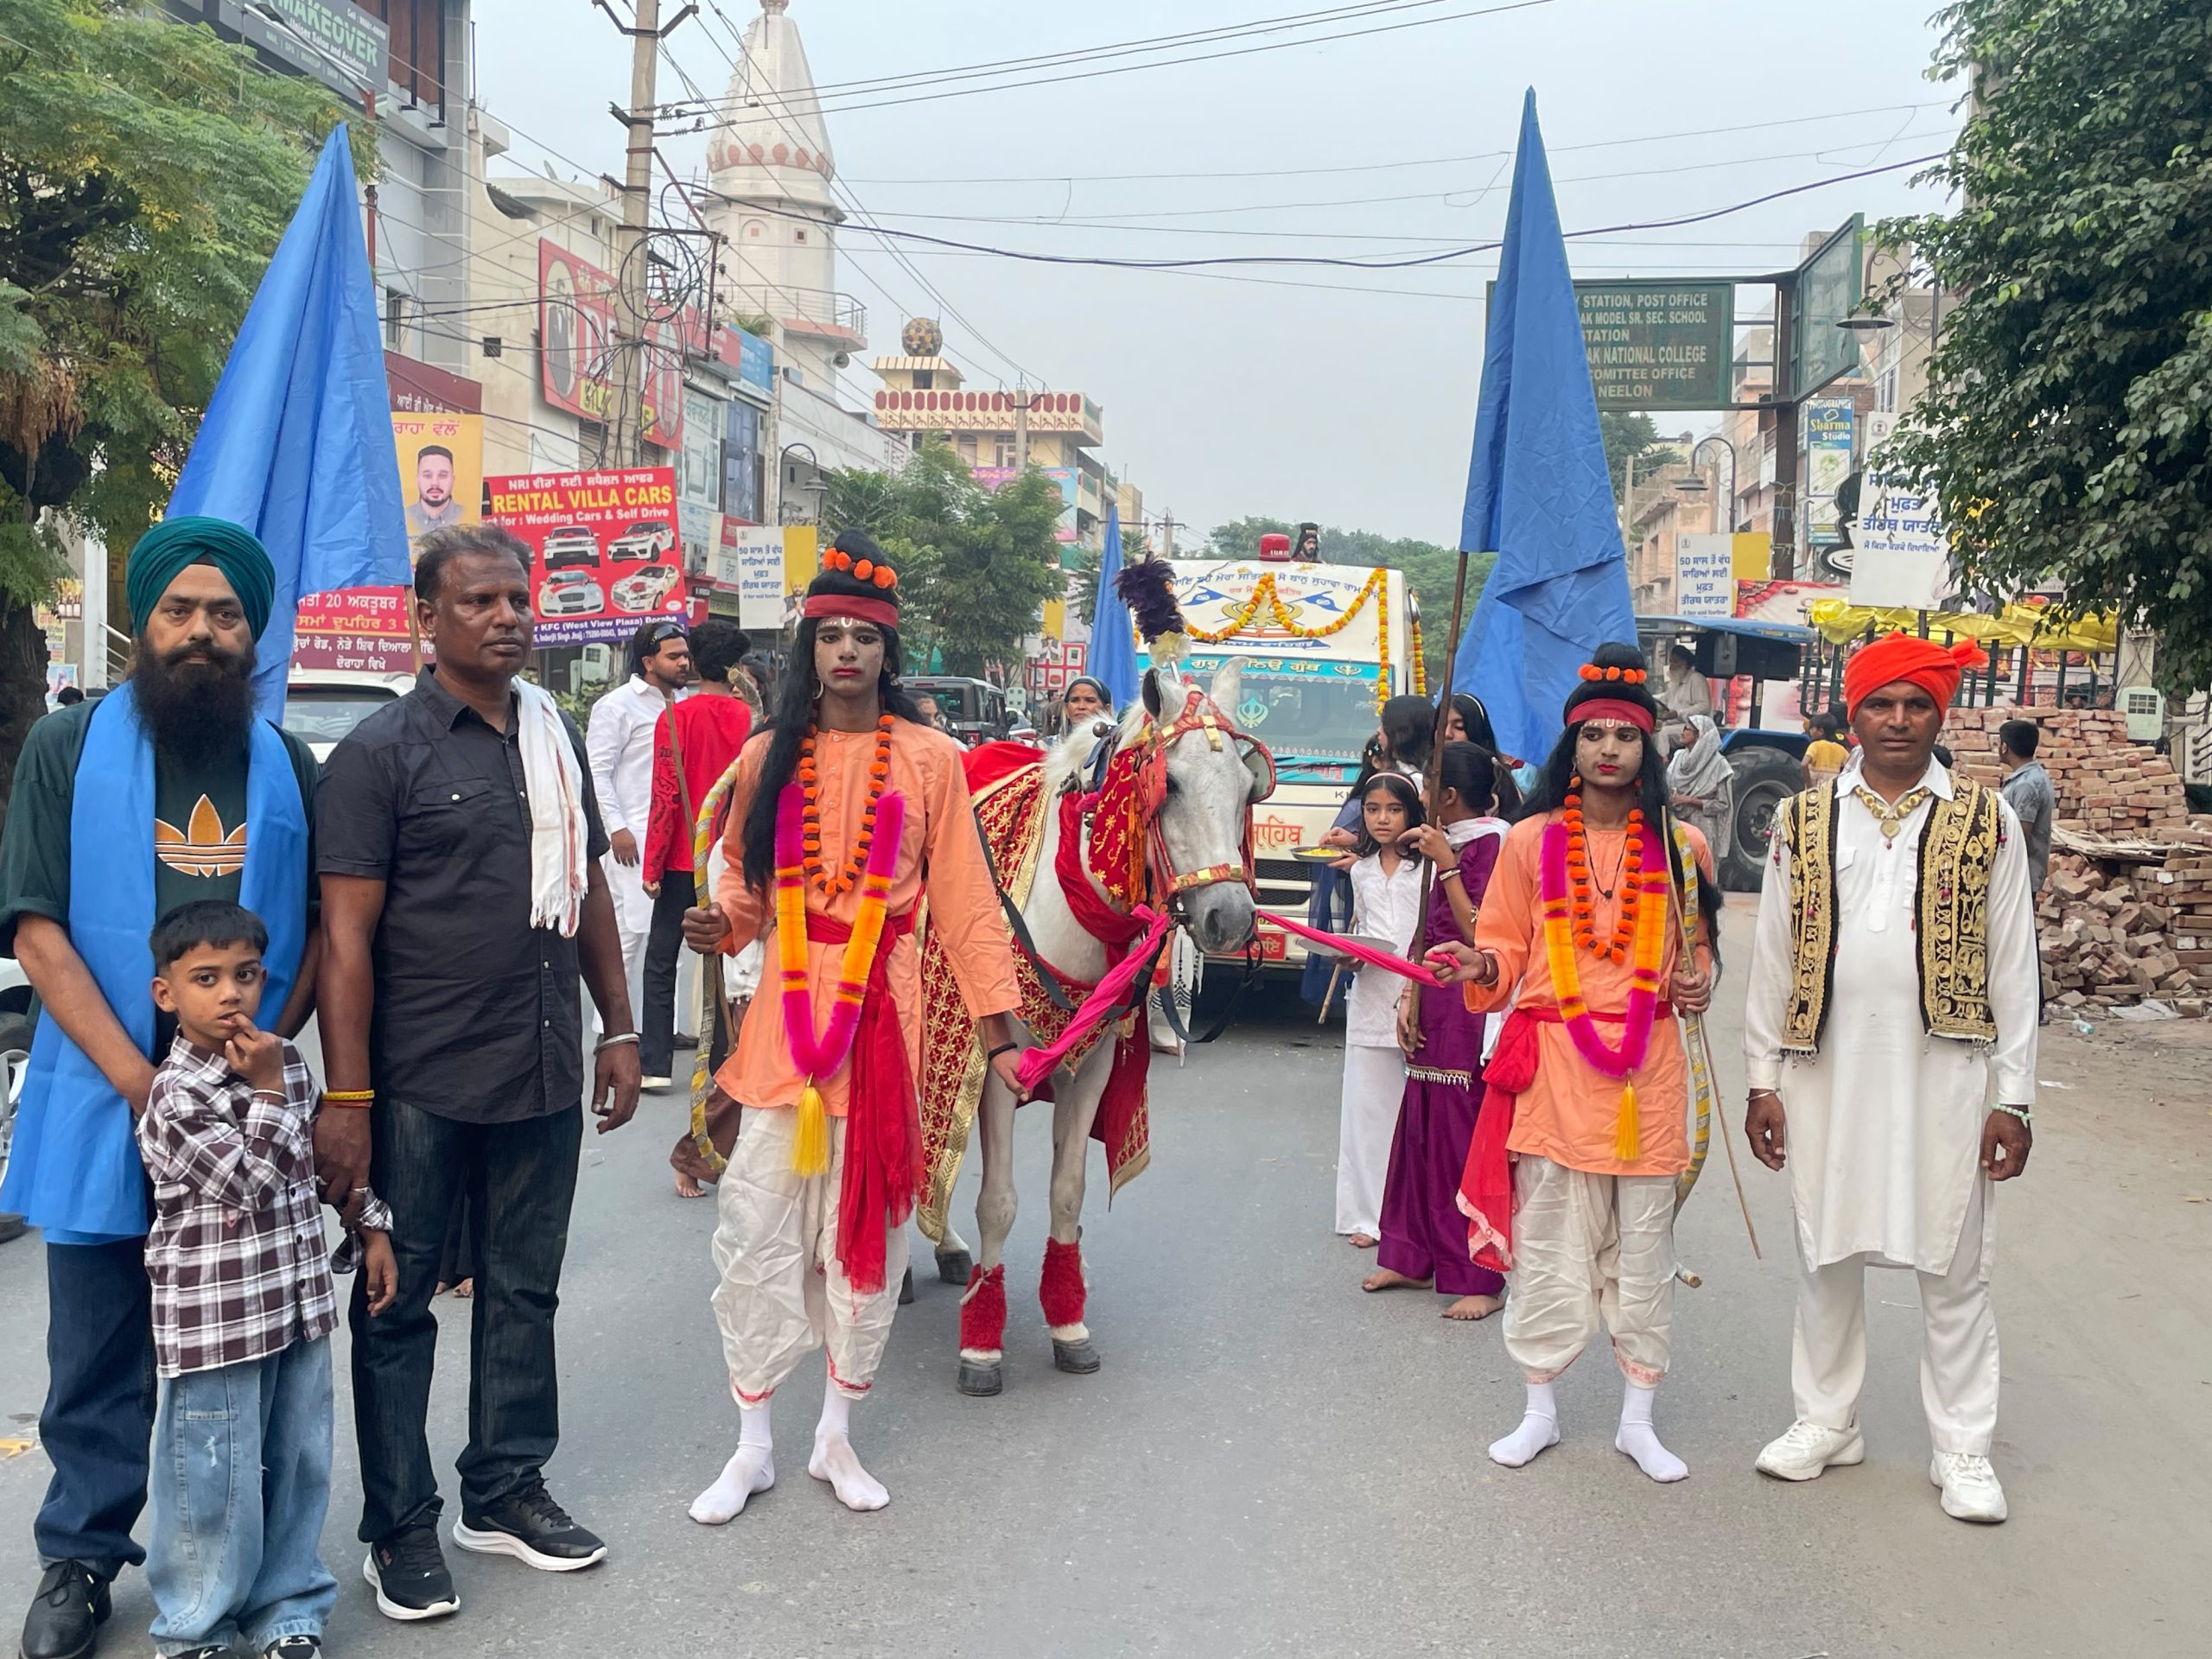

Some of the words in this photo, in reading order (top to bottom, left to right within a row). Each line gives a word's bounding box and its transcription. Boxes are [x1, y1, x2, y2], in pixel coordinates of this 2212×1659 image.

[1583, 295, 1633, 308] STATION,
[1637, 295, 1666, 307] POST
[1669, 294, 1707, 306] OFFICE
[1595, 312, 1626, 325] MODEL
[1629, 312, 1643, 324] SR.
[1646, 312, 1667, 324] SEC.
[1669, 311, 1707, 323] SCHOOL
[1603, 347, 1655, 364] NATIONAL
[1658, 346, 1707, 363] COLLEGE
[1651, 368, 1696, 379] OFFICE
[1599, 385, 1653, 397] NEELON
[393, 422, 425, 435] ਰਾਹਾ
[1811, 419, 1851, 431] Sharma
[1821, 431, 1851, 441] Studio
[509, 480, 530, 491] NRI
[493, 492, 564, 513] RENTAL
[568, 488, 621, 510] VILLA
[625, 485, 673, 505] CARS
[525, 513, 574, 525] Wedding
[578, 511, 601, 522] Cars
[605, 509, 613, 519] &
[616, 508, 638, 520] Self
[641, 506, 670, 518] Drive
[1902, 518, 1942, 534] ਯਾਤਰ
[1680, 556, 1691, 566] 50
[326, 594, 341, 607] 20
[388, 619, 397, 630] 3
[541, 623, 560, 632] KFC
[563, 620, 588, 631] (West
[590, 618, 613, 628] View
[616, 617, 643, 626] Plaza)
